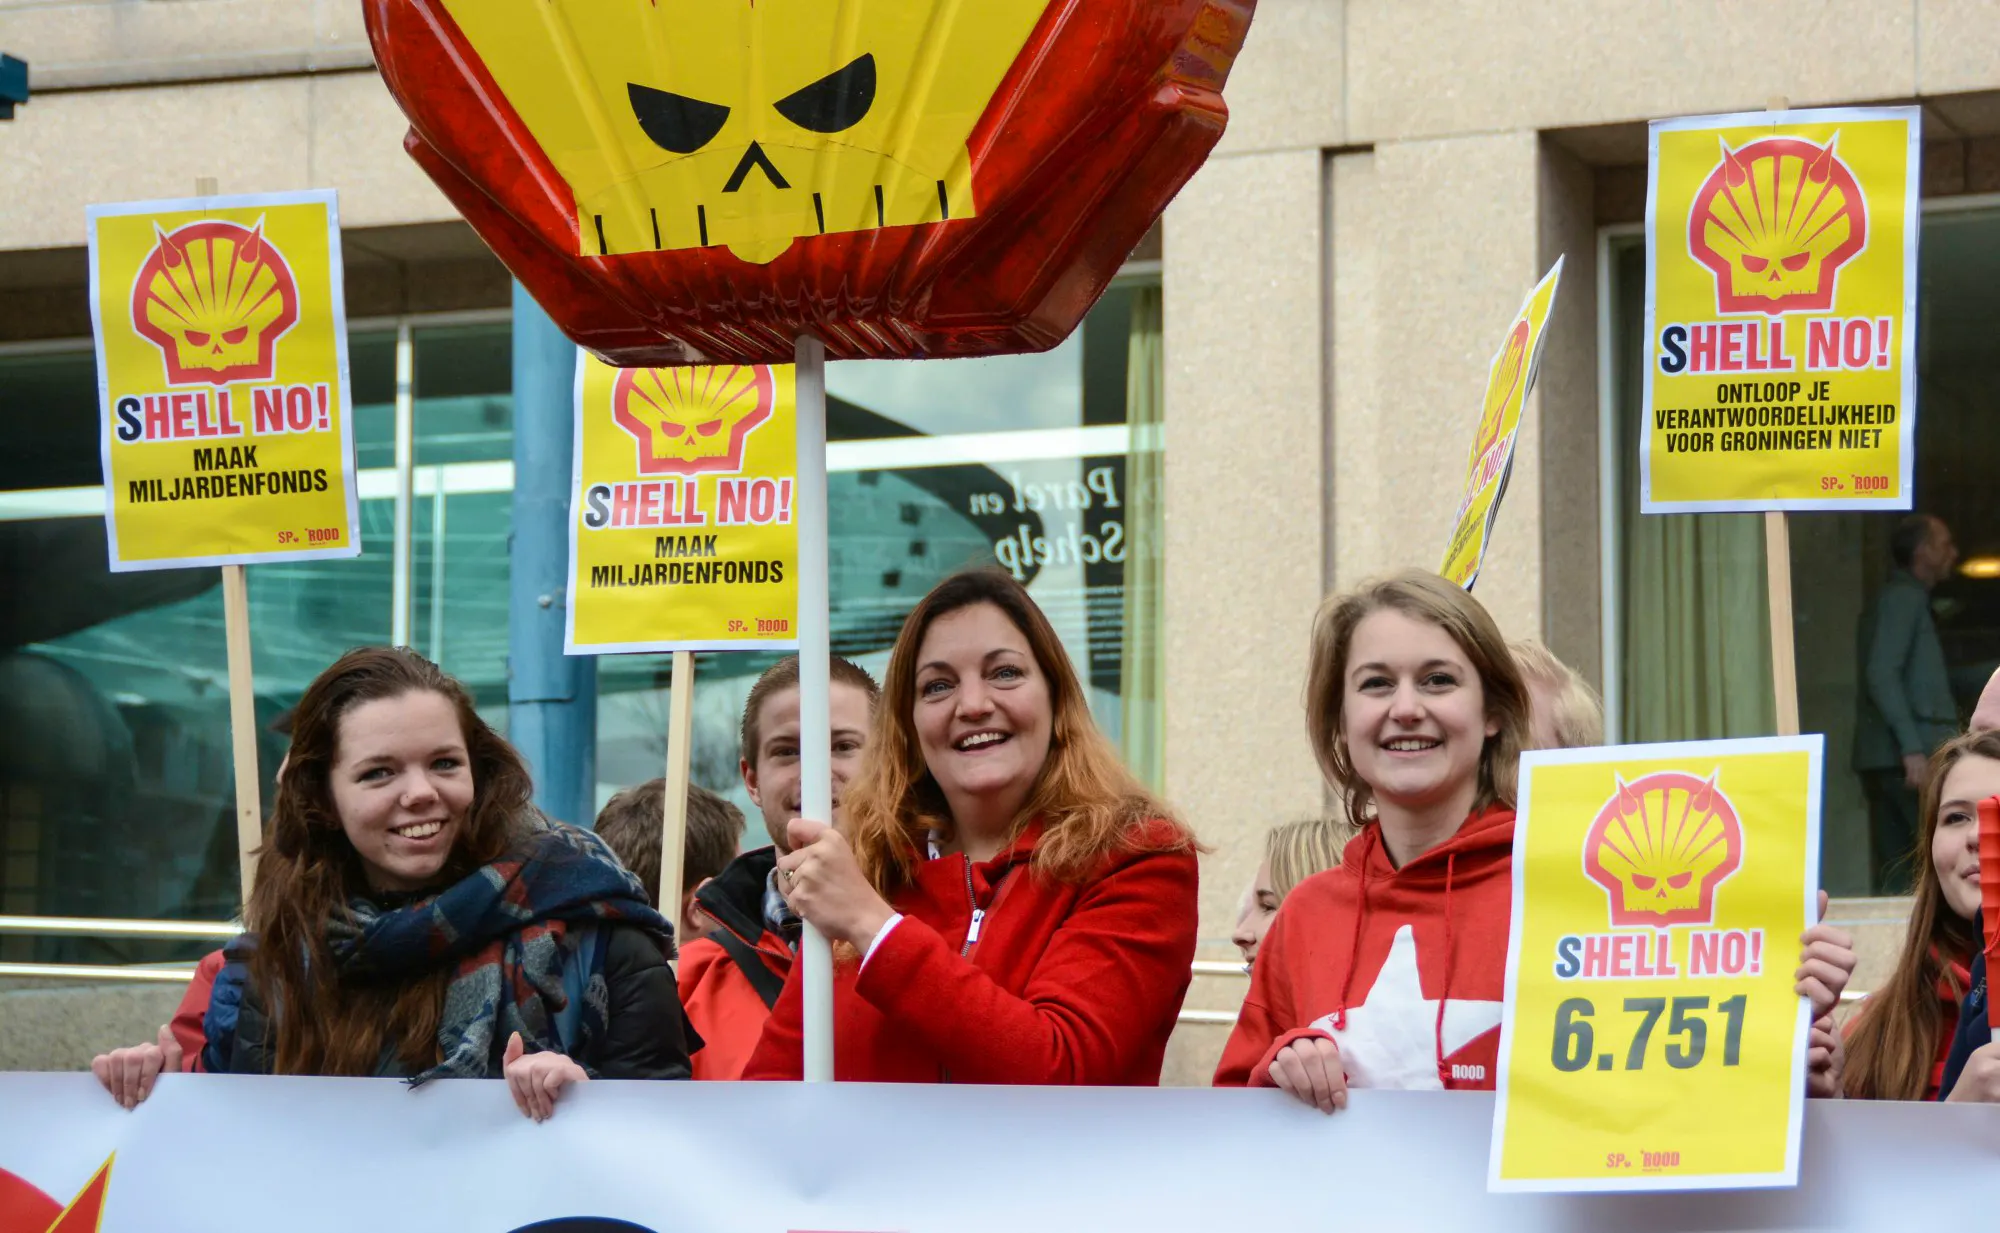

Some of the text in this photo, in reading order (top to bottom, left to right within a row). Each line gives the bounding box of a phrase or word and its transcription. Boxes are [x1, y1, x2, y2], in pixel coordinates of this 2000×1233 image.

[1660, 319, 1889, 374] SHELL NO!
[1717, 380, 1830, 404] ONTLOOP JE
[117, 385, 329, 442] SHELL NO!
[1655, 404, 1896, 430] VERANTWOORDELIJKHEID
[1666, 428, 1883, 453] VOOR GRONINGEN NIET
[193, 445, 258, 472] MAAK
[129, 468, 329, 504] MILJARDENFONDS
[1854, 475, 1889, 491] ROOD
[585, 479, 792, 528] SHELL NO!
[307, 528, 340, 542] ROOD
[654, 534, 719, 559] MAAK
[591, 560, 784, 589] MILJARDENFONDS
[757, 619, 789, 632] ROOD
[1555, 931, 1762, 979] SHELL NO!
[1550, 994, 1748, 1073] 6.751
[1451, 1064, 1485, 1080] ROOD
[1641, 1151, 1681, 1168] ROOD
